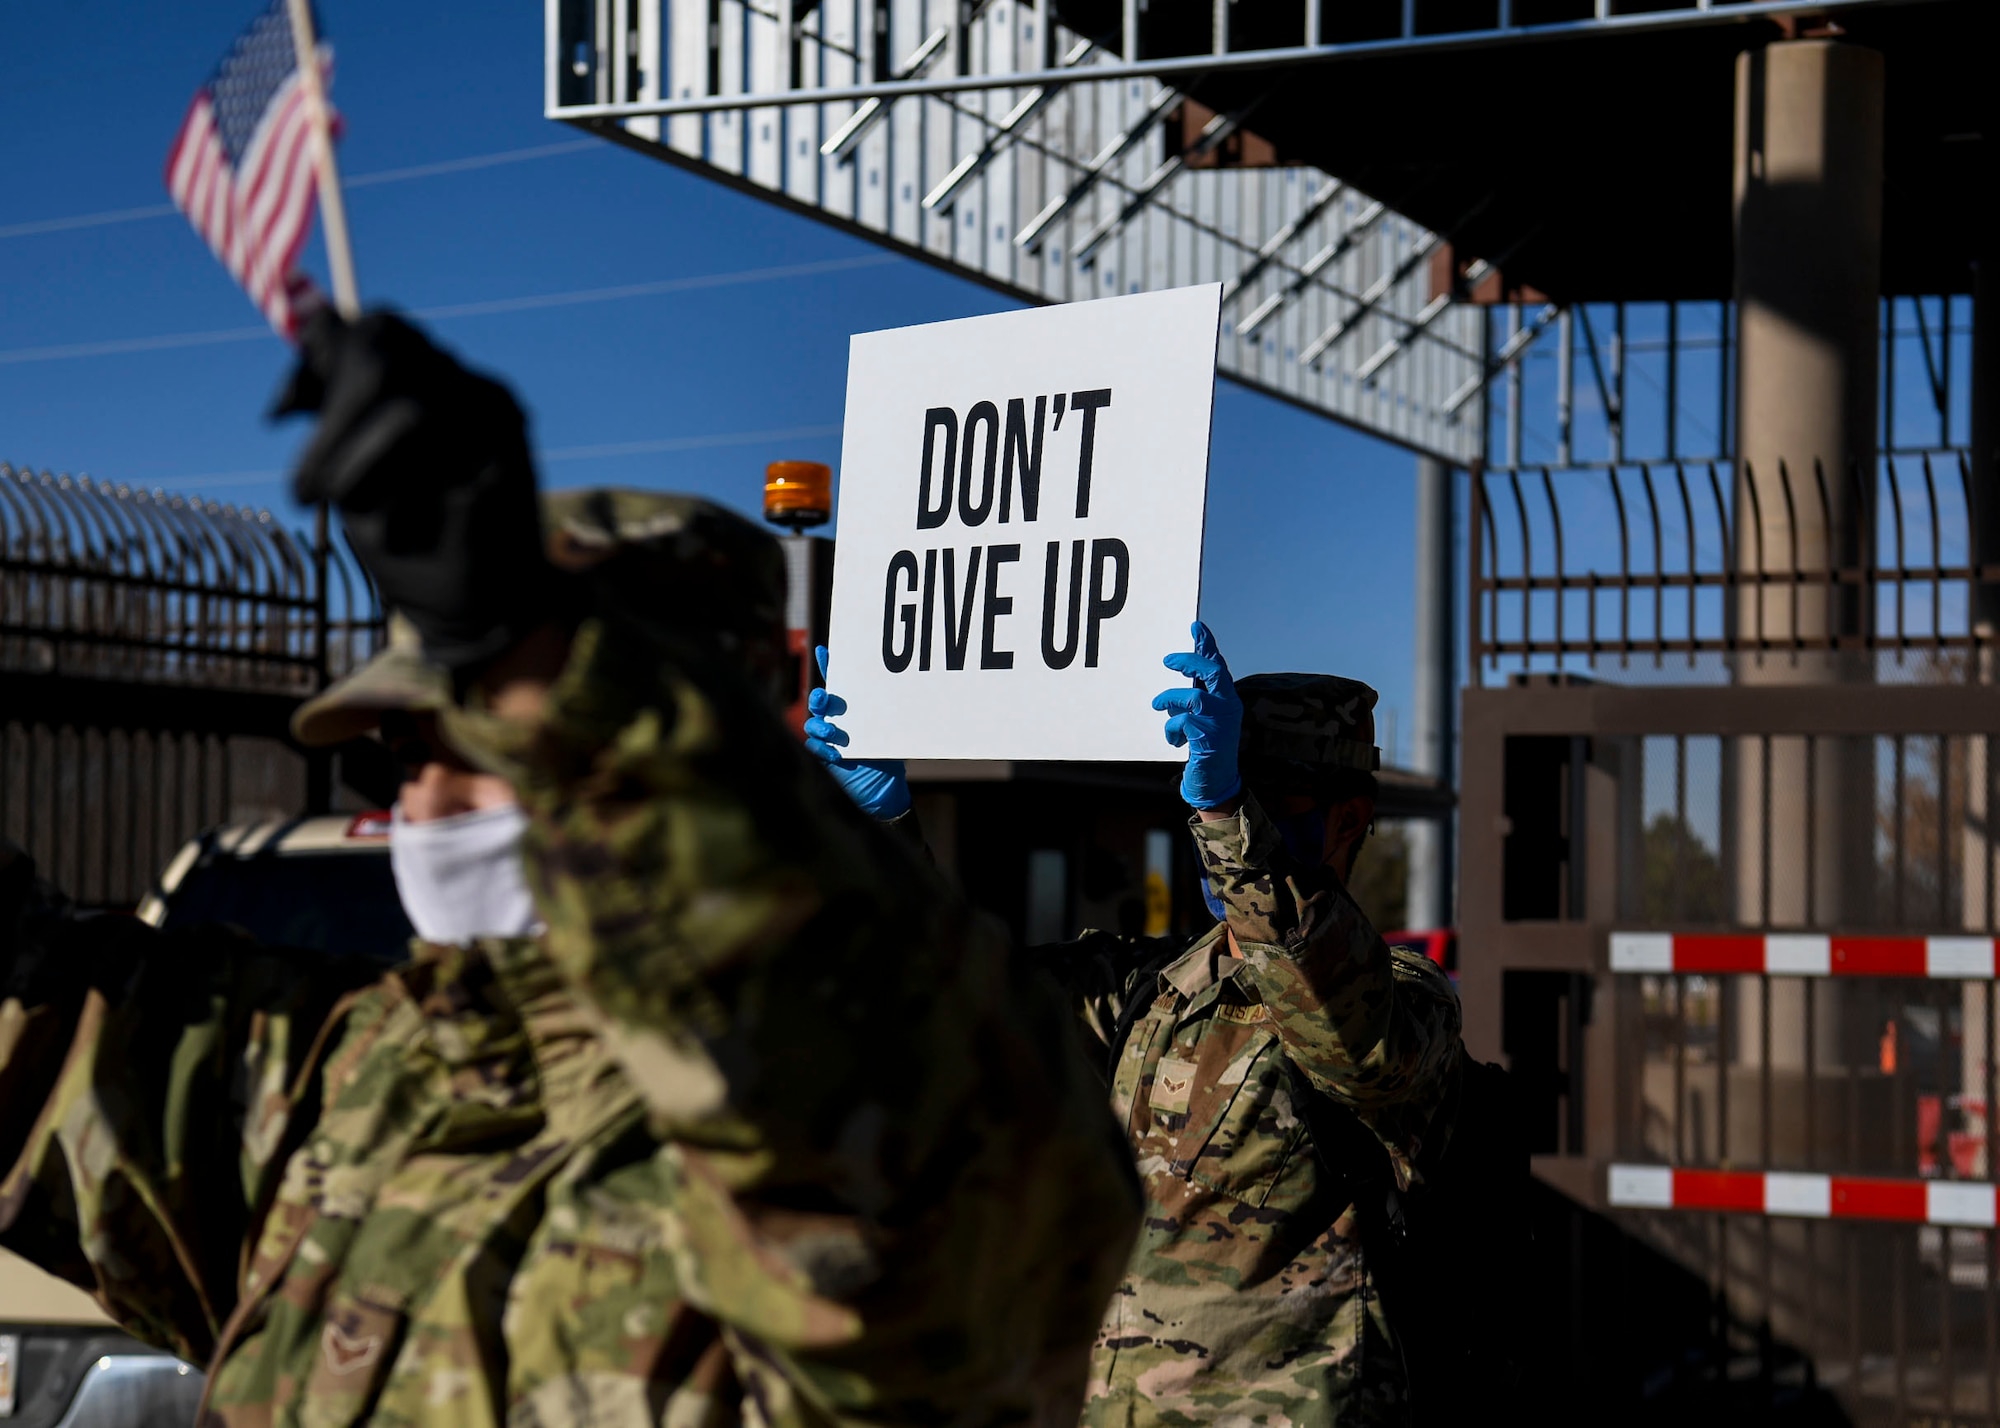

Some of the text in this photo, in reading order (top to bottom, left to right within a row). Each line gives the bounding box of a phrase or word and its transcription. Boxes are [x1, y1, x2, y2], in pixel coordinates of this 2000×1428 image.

[916, 388, 1112, 530] DON’T
[881, 537, 1130, 674] GIVE UP
